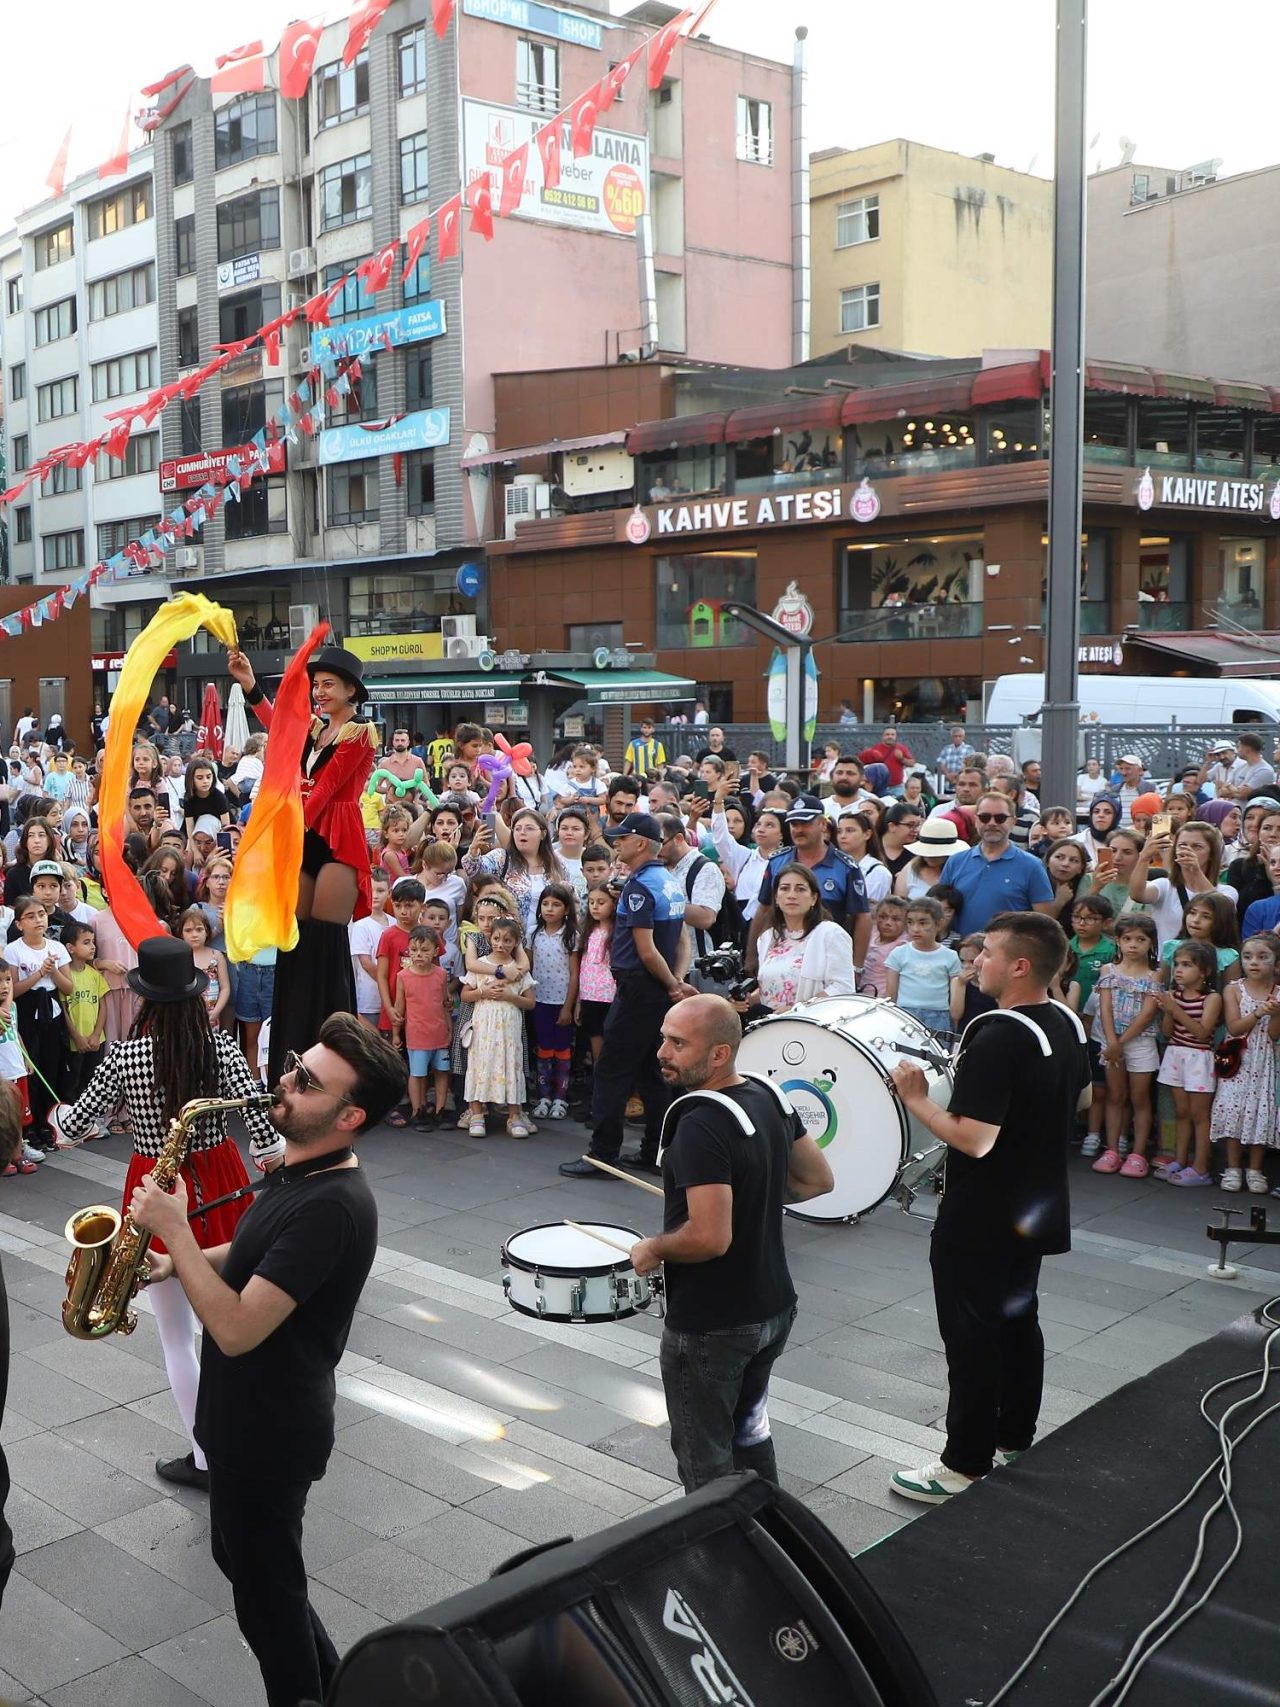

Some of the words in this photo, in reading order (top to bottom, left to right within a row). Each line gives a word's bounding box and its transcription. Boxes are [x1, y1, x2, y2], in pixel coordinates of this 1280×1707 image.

[561, 164, 594, 182] eber
[408, 311, 433, 326] FATSA
[162, 480, 176, 489] CHP
[1162, 476, 1217, 507] KAHVE
[1219, 481, 1264, 512] ATEŞİ
[657, 499, 749, 534] KAHVE
[756, 489, 842, 525] ATEŞİ
[370, 644, 398, 656] SHOP'M
[398, 643, 424, 655] GÜROL
[75, 990, 91, 1000] 907
